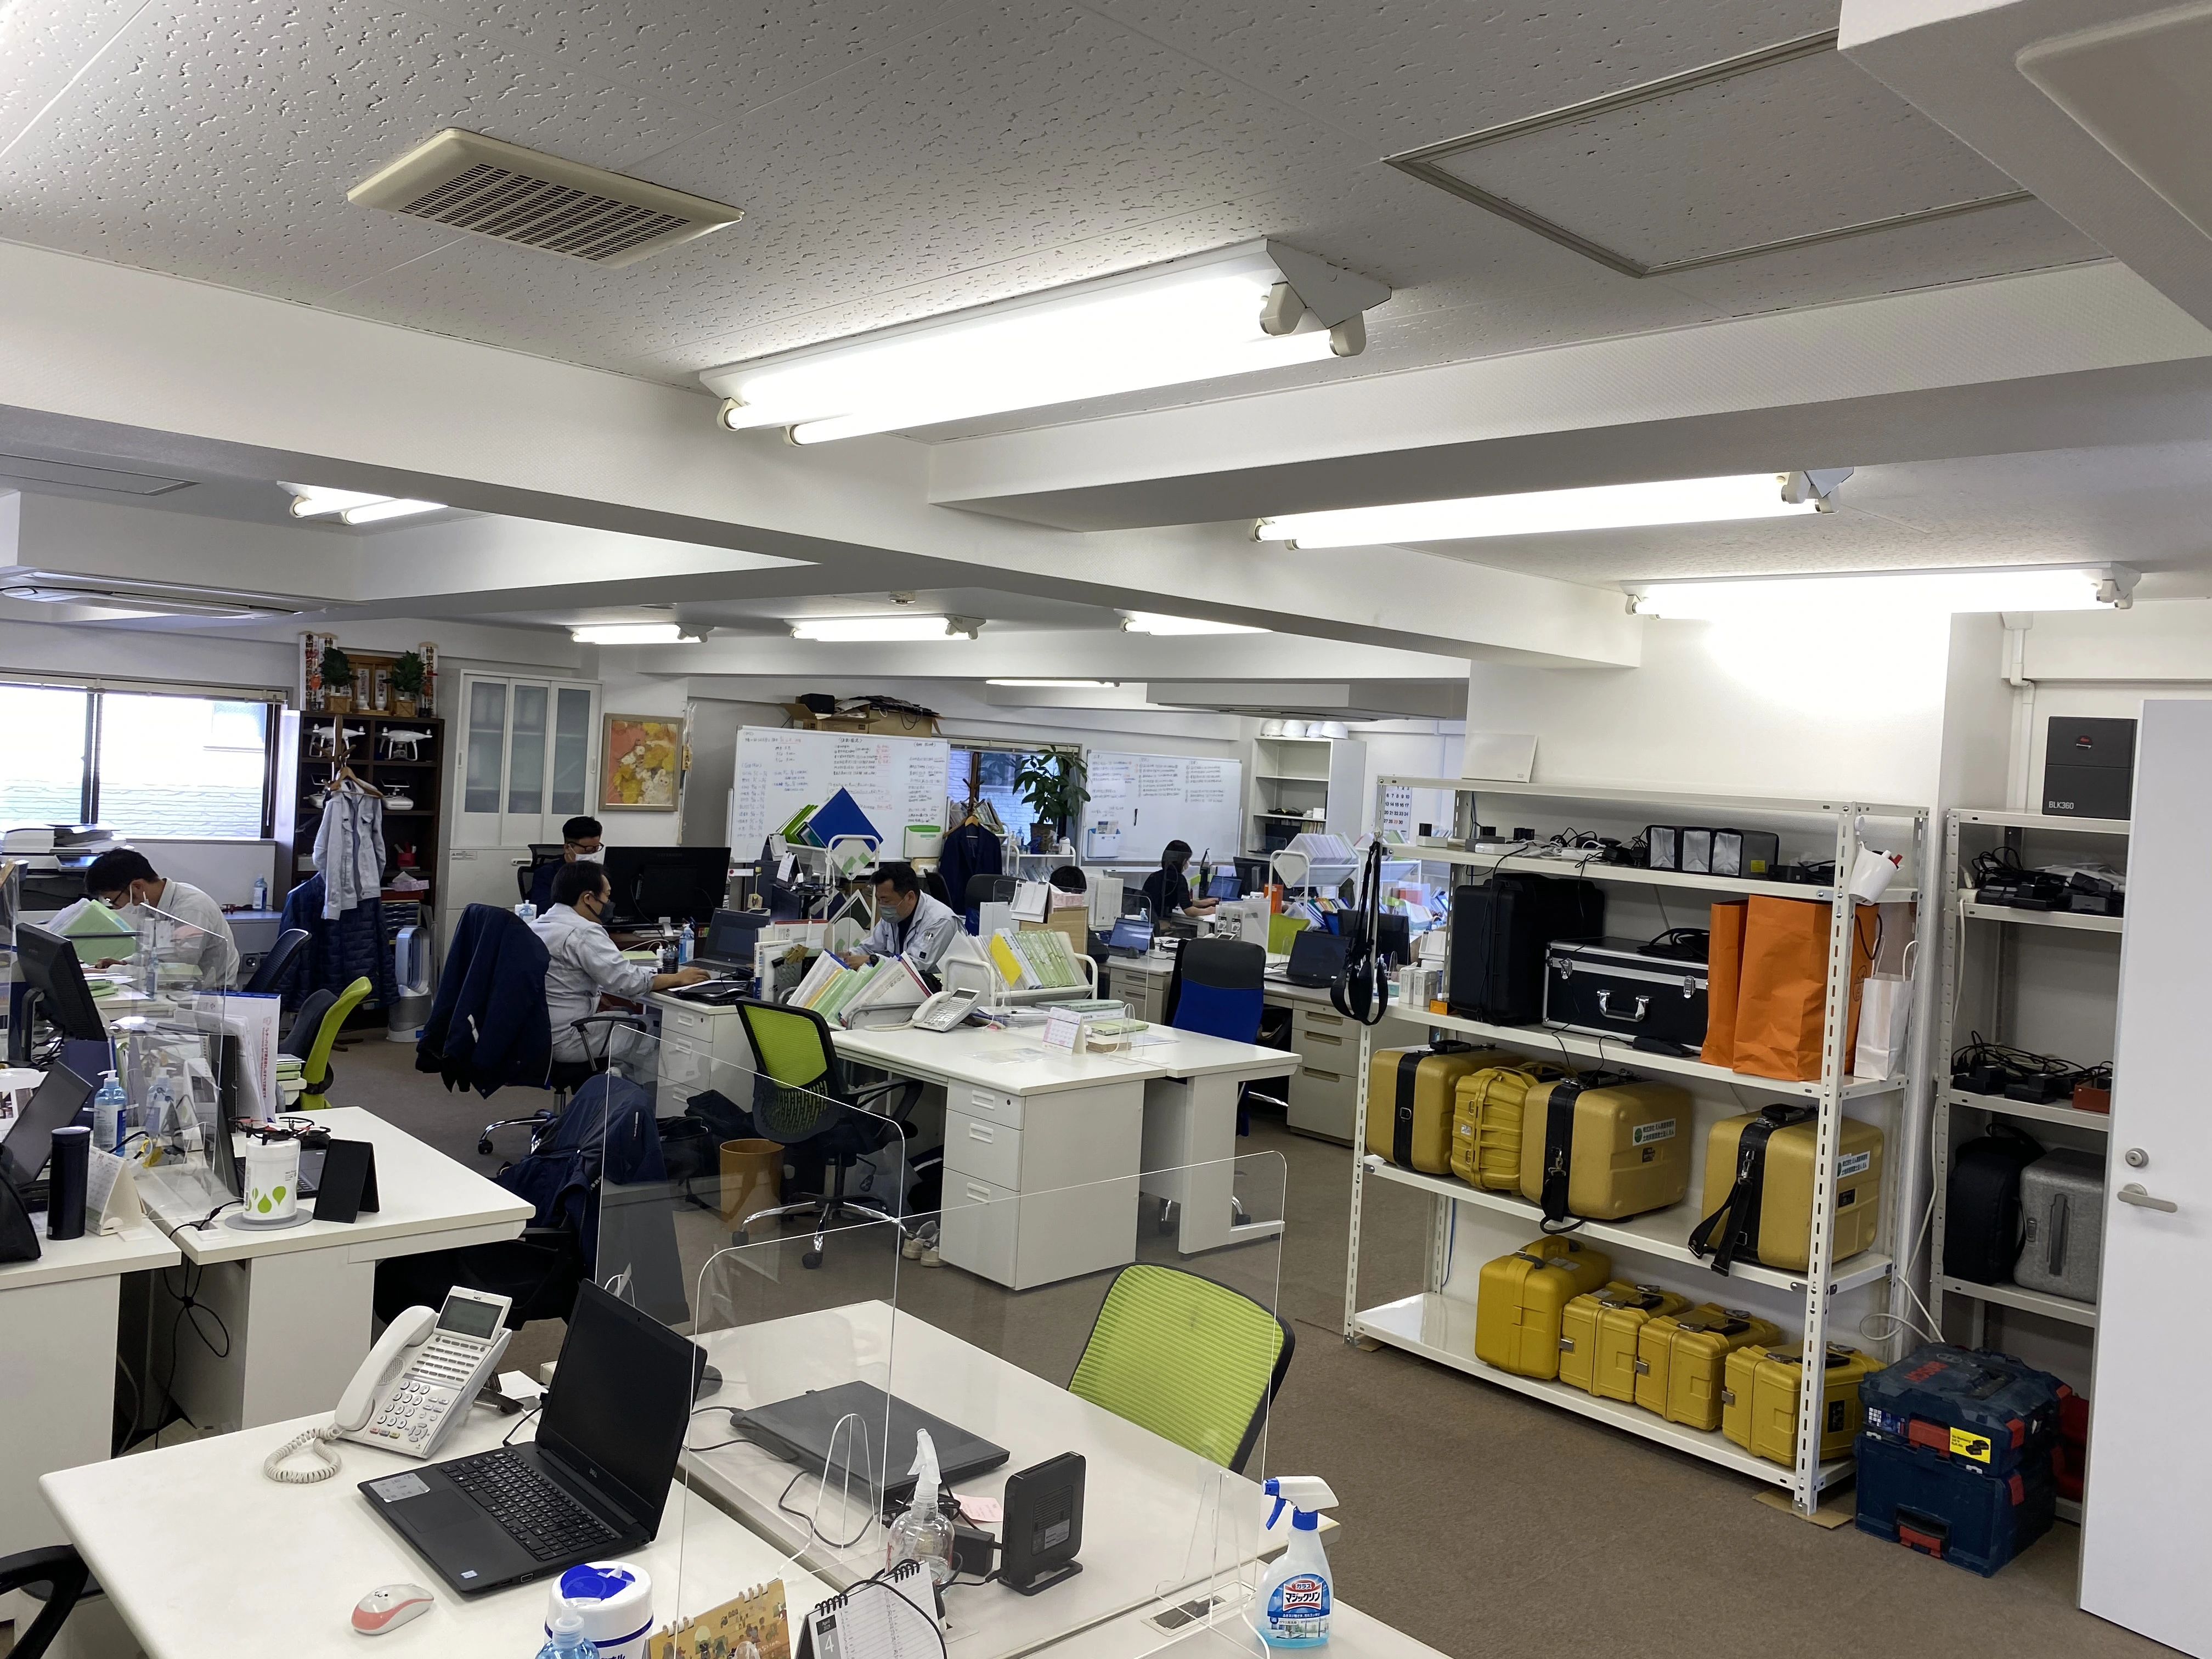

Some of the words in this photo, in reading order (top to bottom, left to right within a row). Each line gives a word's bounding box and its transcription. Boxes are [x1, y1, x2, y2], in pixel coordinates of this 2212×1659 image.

[2049, 801, 2074, 810] BLK360
[589, 1468, 597, 1478] DELL
[1285, 1592, 1321, 1603] マジックリン
[825, 1634, 834, 1652] 4
